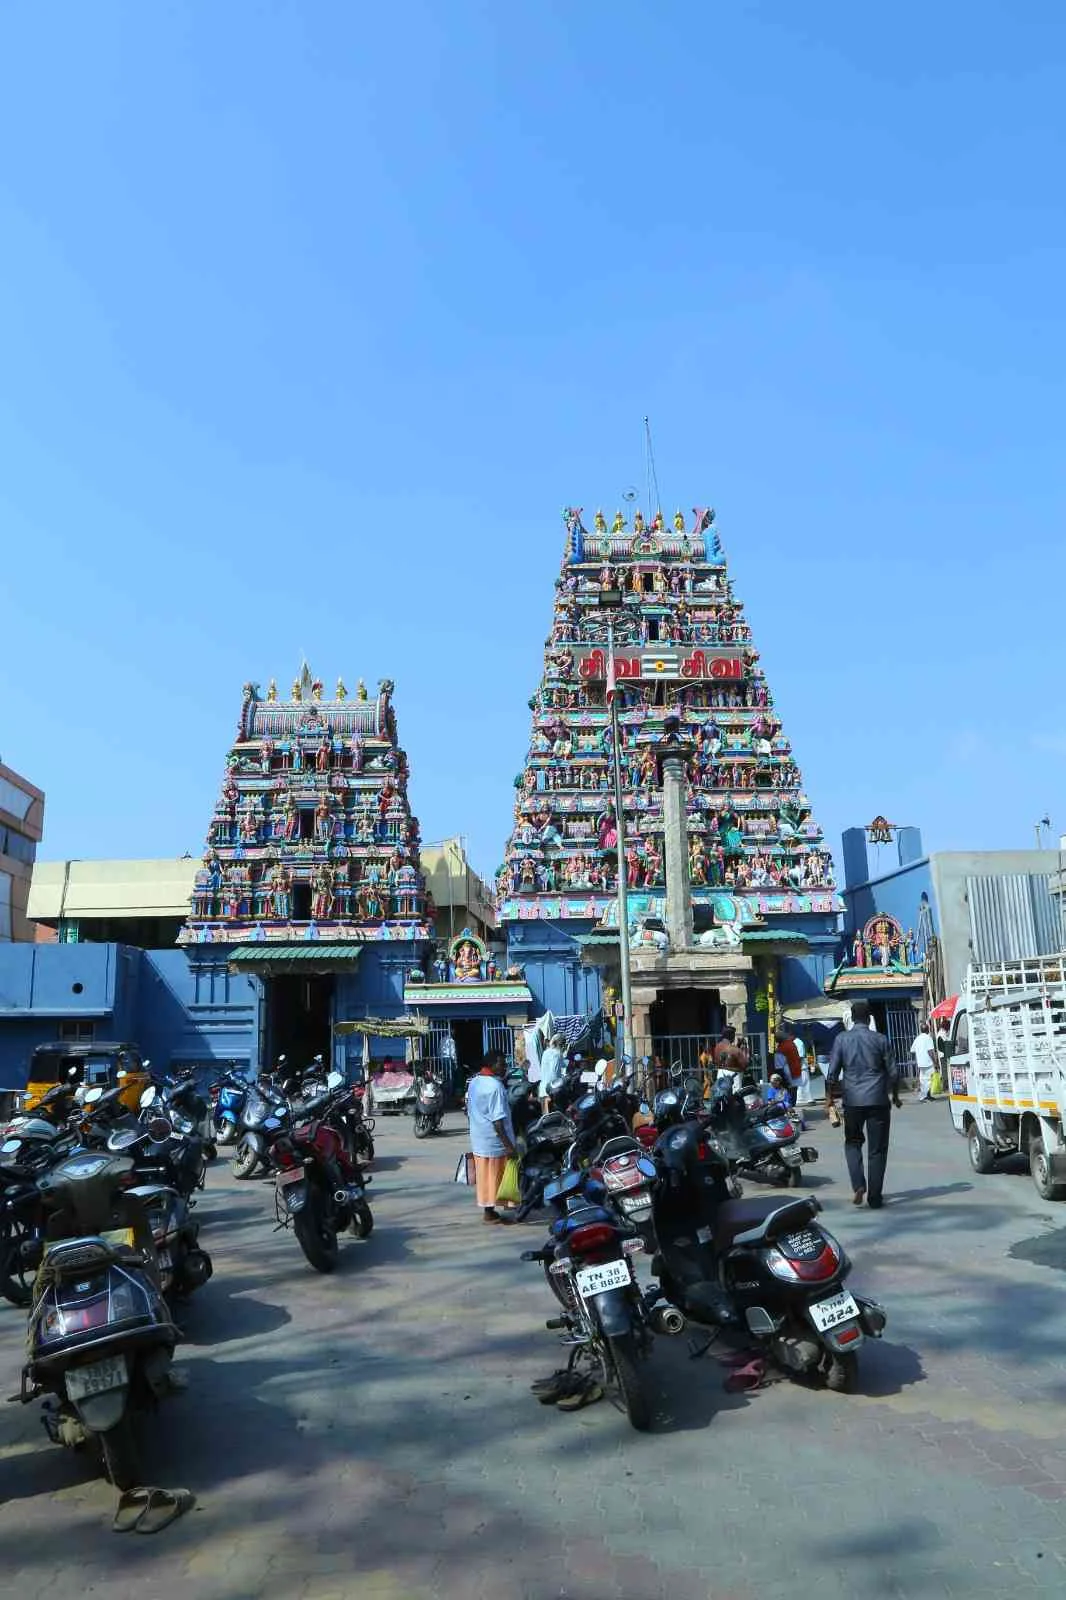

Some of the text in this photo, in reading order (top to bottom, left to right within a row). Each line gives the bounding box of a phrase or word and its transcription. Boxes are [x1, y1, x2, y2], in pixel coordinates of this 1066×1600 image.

[680, 649, 743, 679] சிவ
[582, 1275, 627, 1293] AE 8822
[587, 1272, 603, 1281] TN
[821, 1305, 854, 1327] 1424
